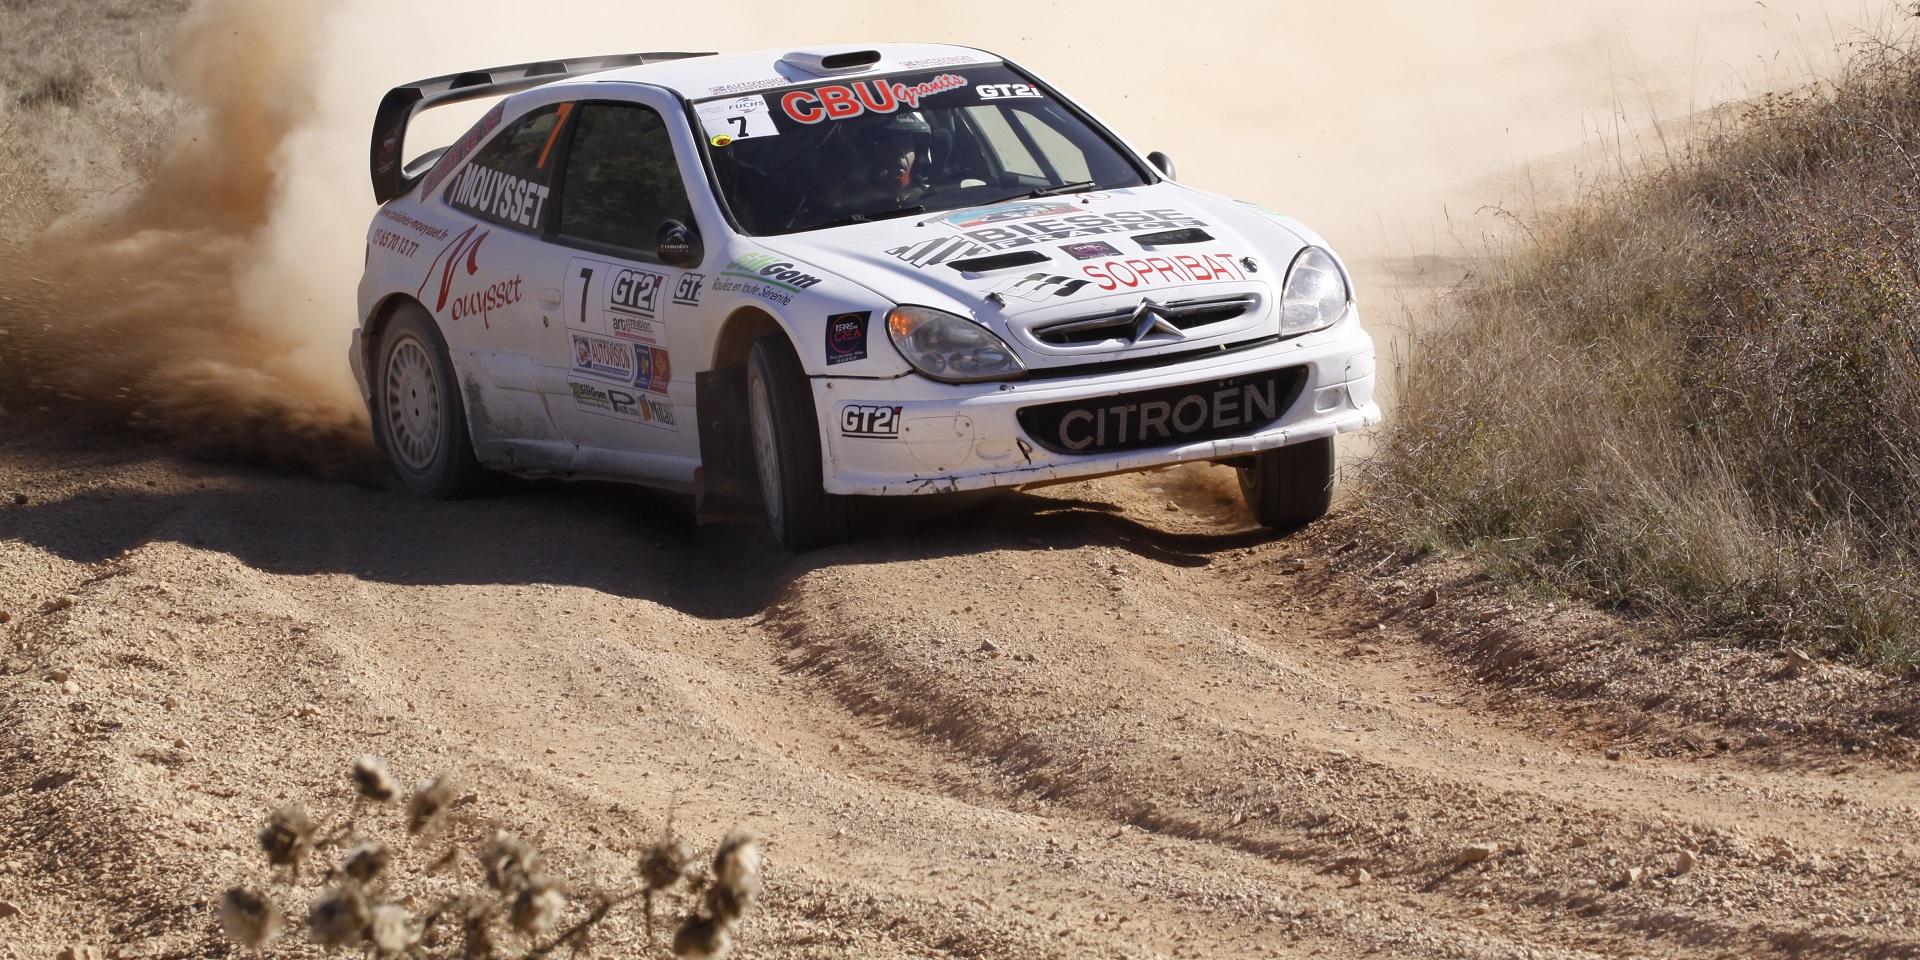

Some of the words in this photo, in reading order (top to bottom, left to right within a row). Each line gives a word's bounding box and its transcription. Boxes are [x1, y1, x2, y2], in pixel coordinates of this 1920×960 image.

[729, 101, 764, 110] FUCHS
[781, 79, 899, 124] CBU
[976, 82, 1041, 98] GT2i
[537, 102, 576, 169] 7
[726, 116, 750, 138] 7
[455, 162, 550, 229] MOUYSSET
[961, 209, 1198, 244] BIESSE
[610, 268, 664, 312] GT2i
[1082, 254, 1247, 291] SOPRIBAT
[579, 267, 594, 323] 7
[841, 404, 903, 435] GT2i
[1060, 378, 1277, 449] CITROËN
